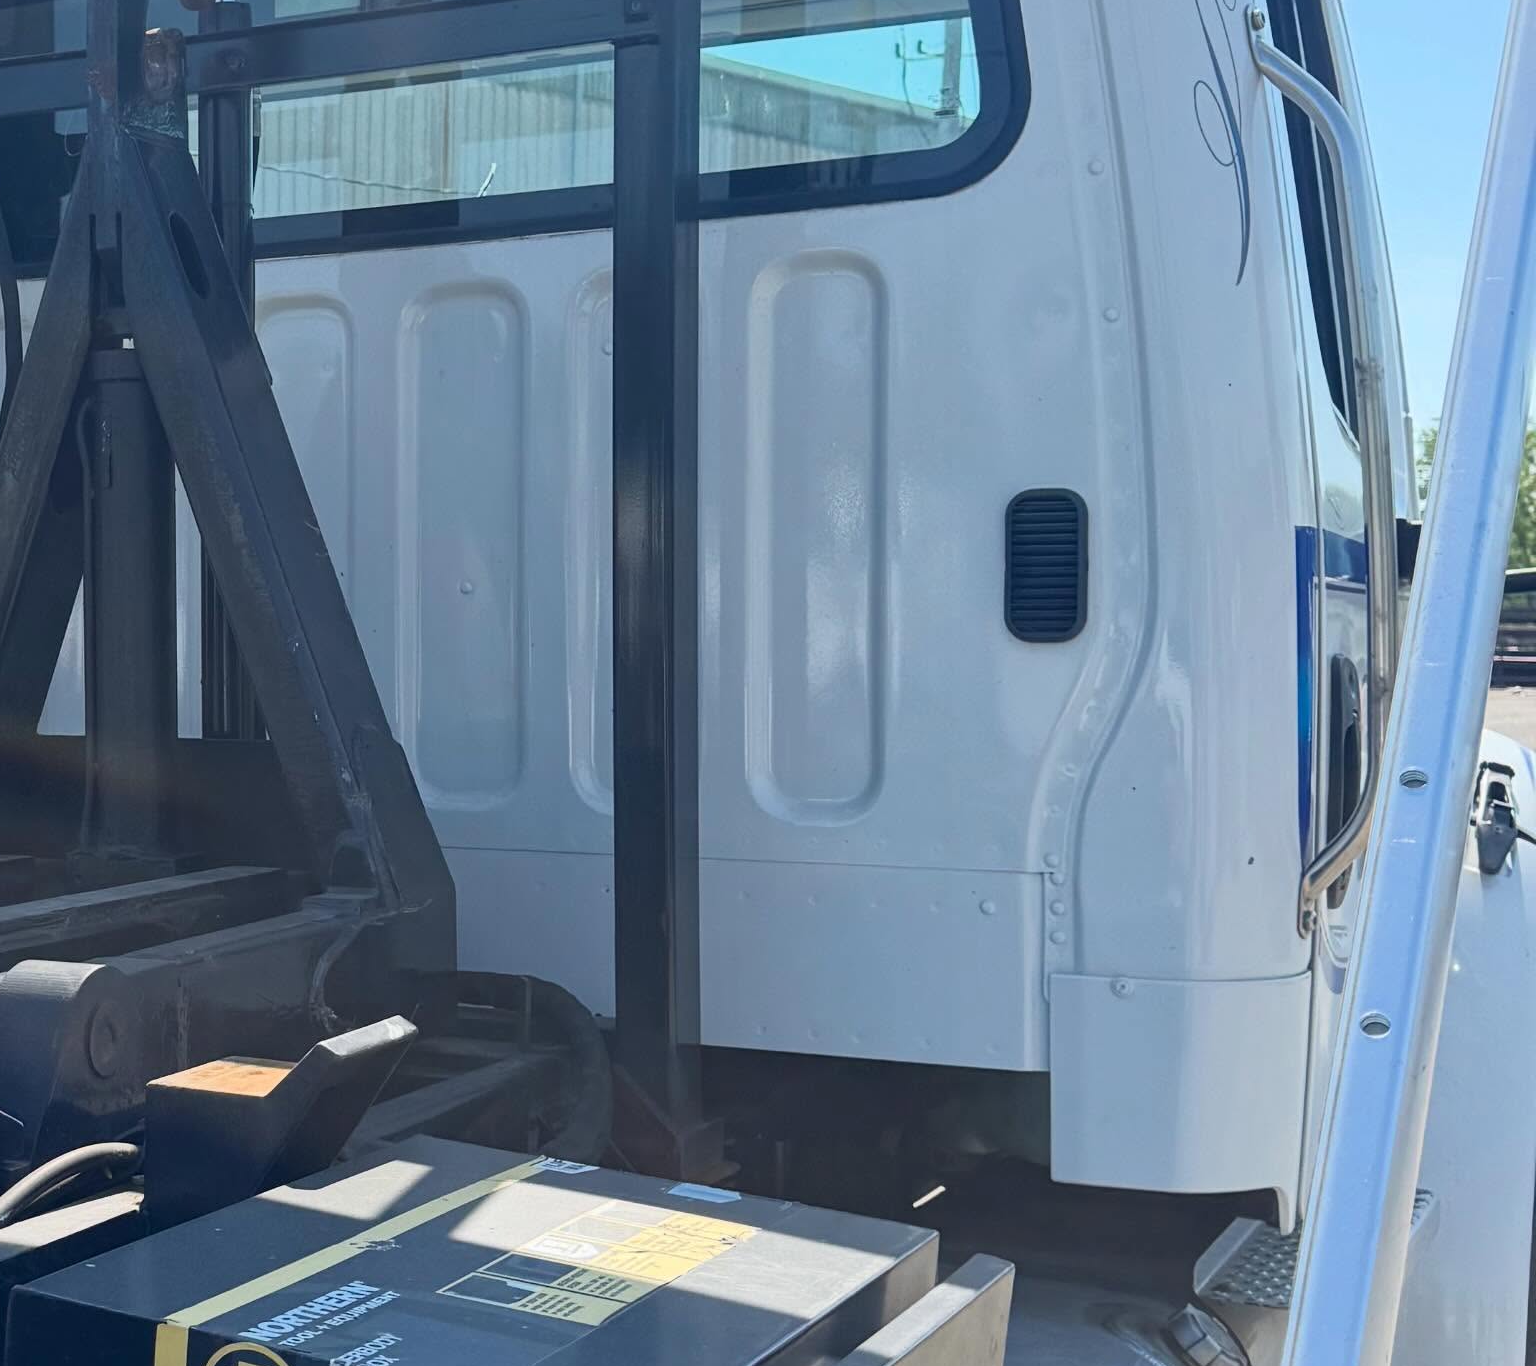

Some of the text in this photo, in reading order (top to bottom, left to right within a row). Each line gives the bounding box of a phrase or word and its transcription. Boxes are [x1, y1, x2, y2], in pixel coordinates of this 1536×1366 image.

[237, 1280, 380, 1342] NORTHERN
[277, 1330, 323, 1347] TOOL
[324, 1290, 401, 1326] EQUIPMENT
